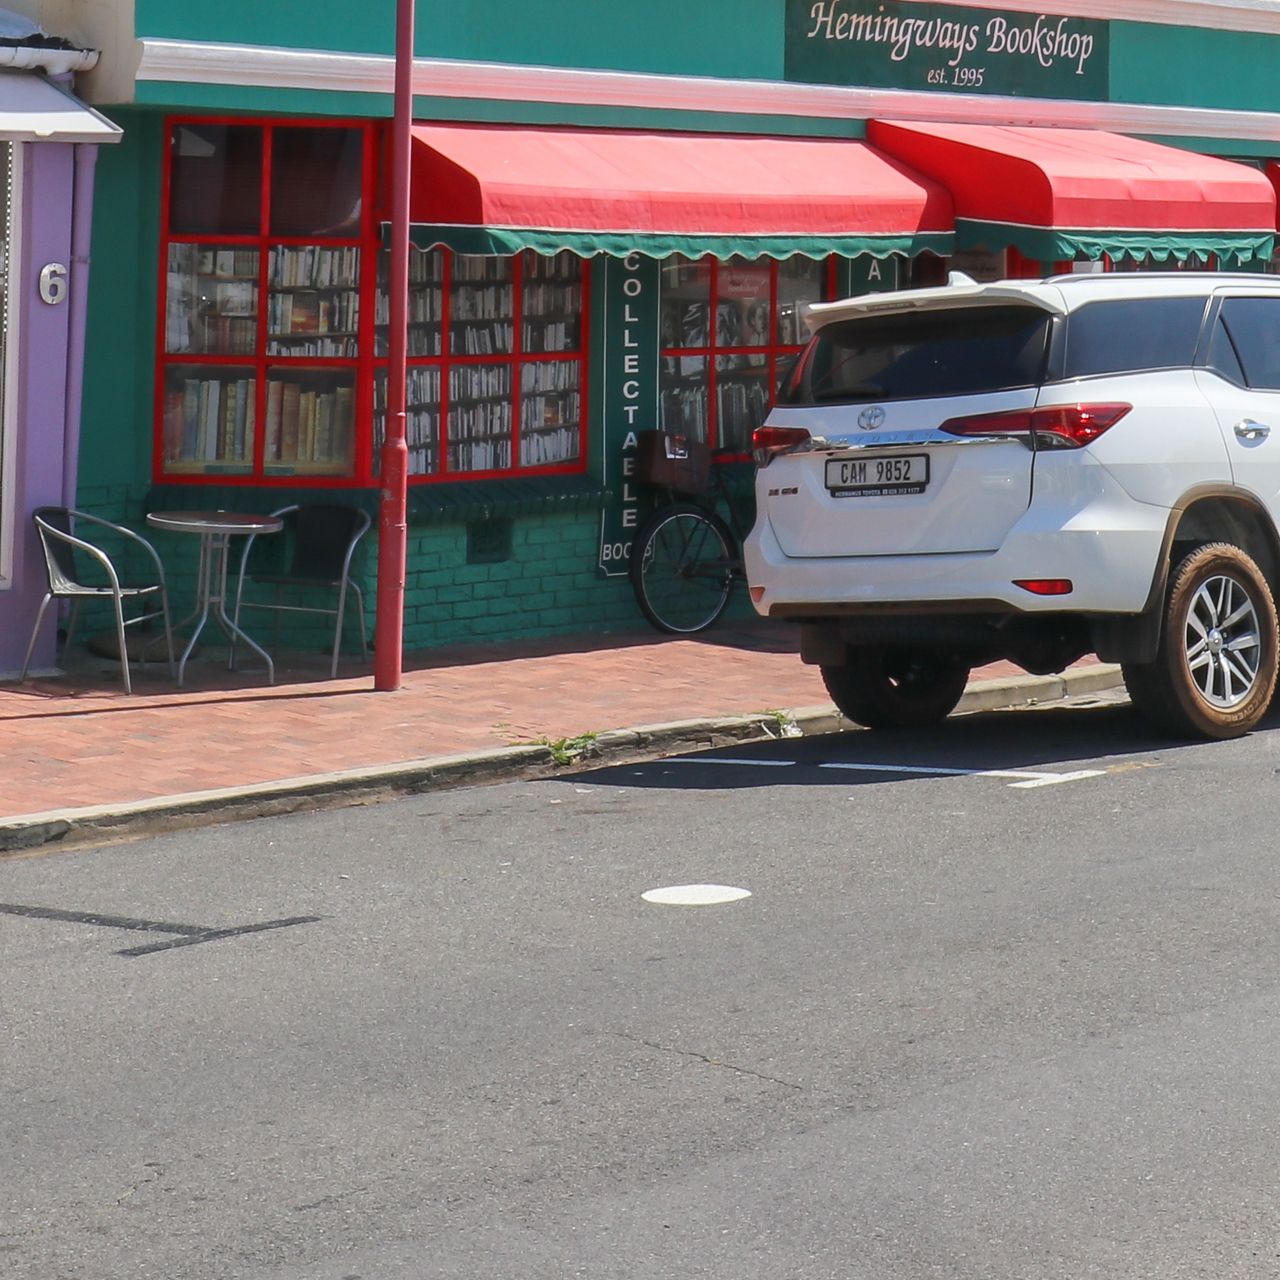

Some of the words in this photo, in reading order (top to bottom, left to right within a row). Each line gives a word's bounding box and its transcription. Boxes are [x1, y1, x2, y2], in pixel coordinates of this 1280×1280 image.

[985, 13, 1095, 75] Bookshop
[927, 69, 949, 84] est.
[951, 66, 986, 88] 1995
[622, 253, 642, 528] COLLECTABLE
[840, 462, 867, 485] CAM
[876, 459, 912, 482] 9852
